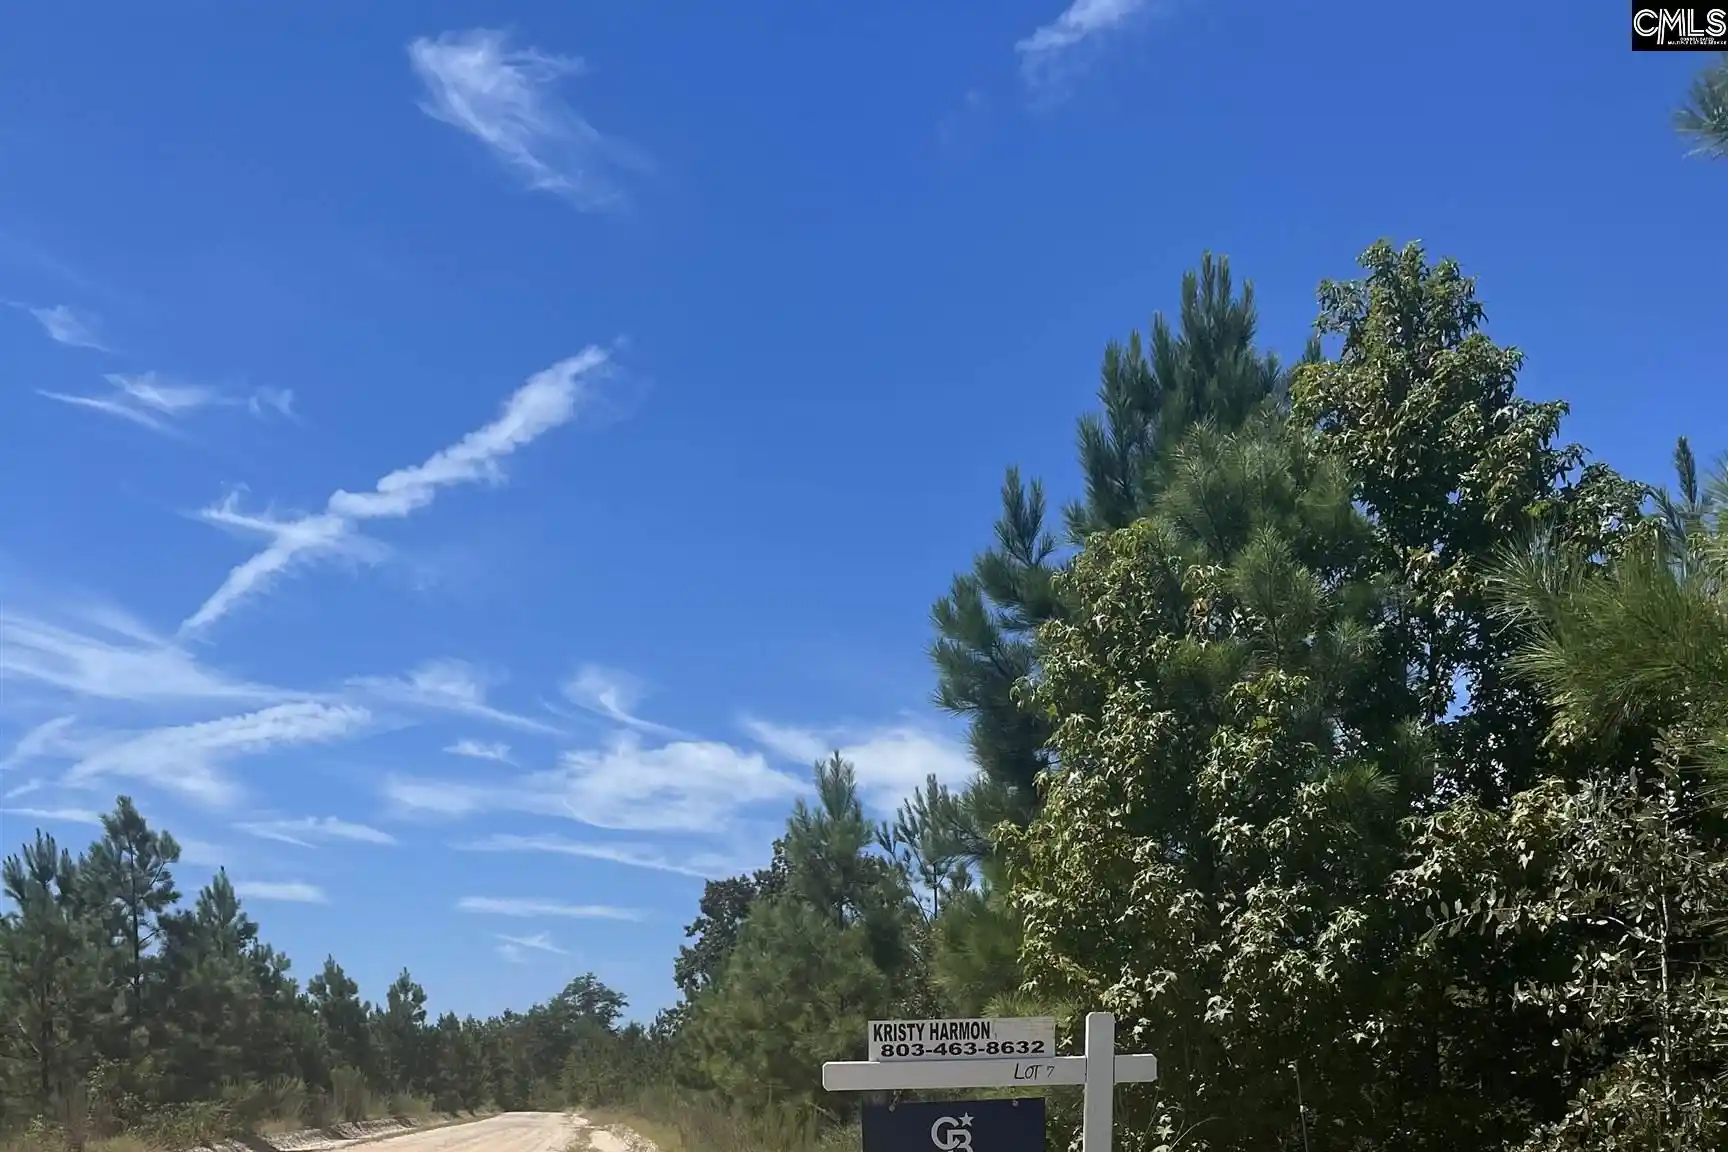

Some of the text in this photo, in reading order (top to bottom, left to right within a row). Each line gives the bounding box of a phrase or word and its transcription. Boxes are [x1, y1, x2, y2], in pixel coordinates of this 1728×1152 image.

[873, 1021, 991, 1042] KRISTY HARMON
[880, 1040, 1045, 1057] 803-463-8632
[1014, 1063, 1044, 1080] LOT
